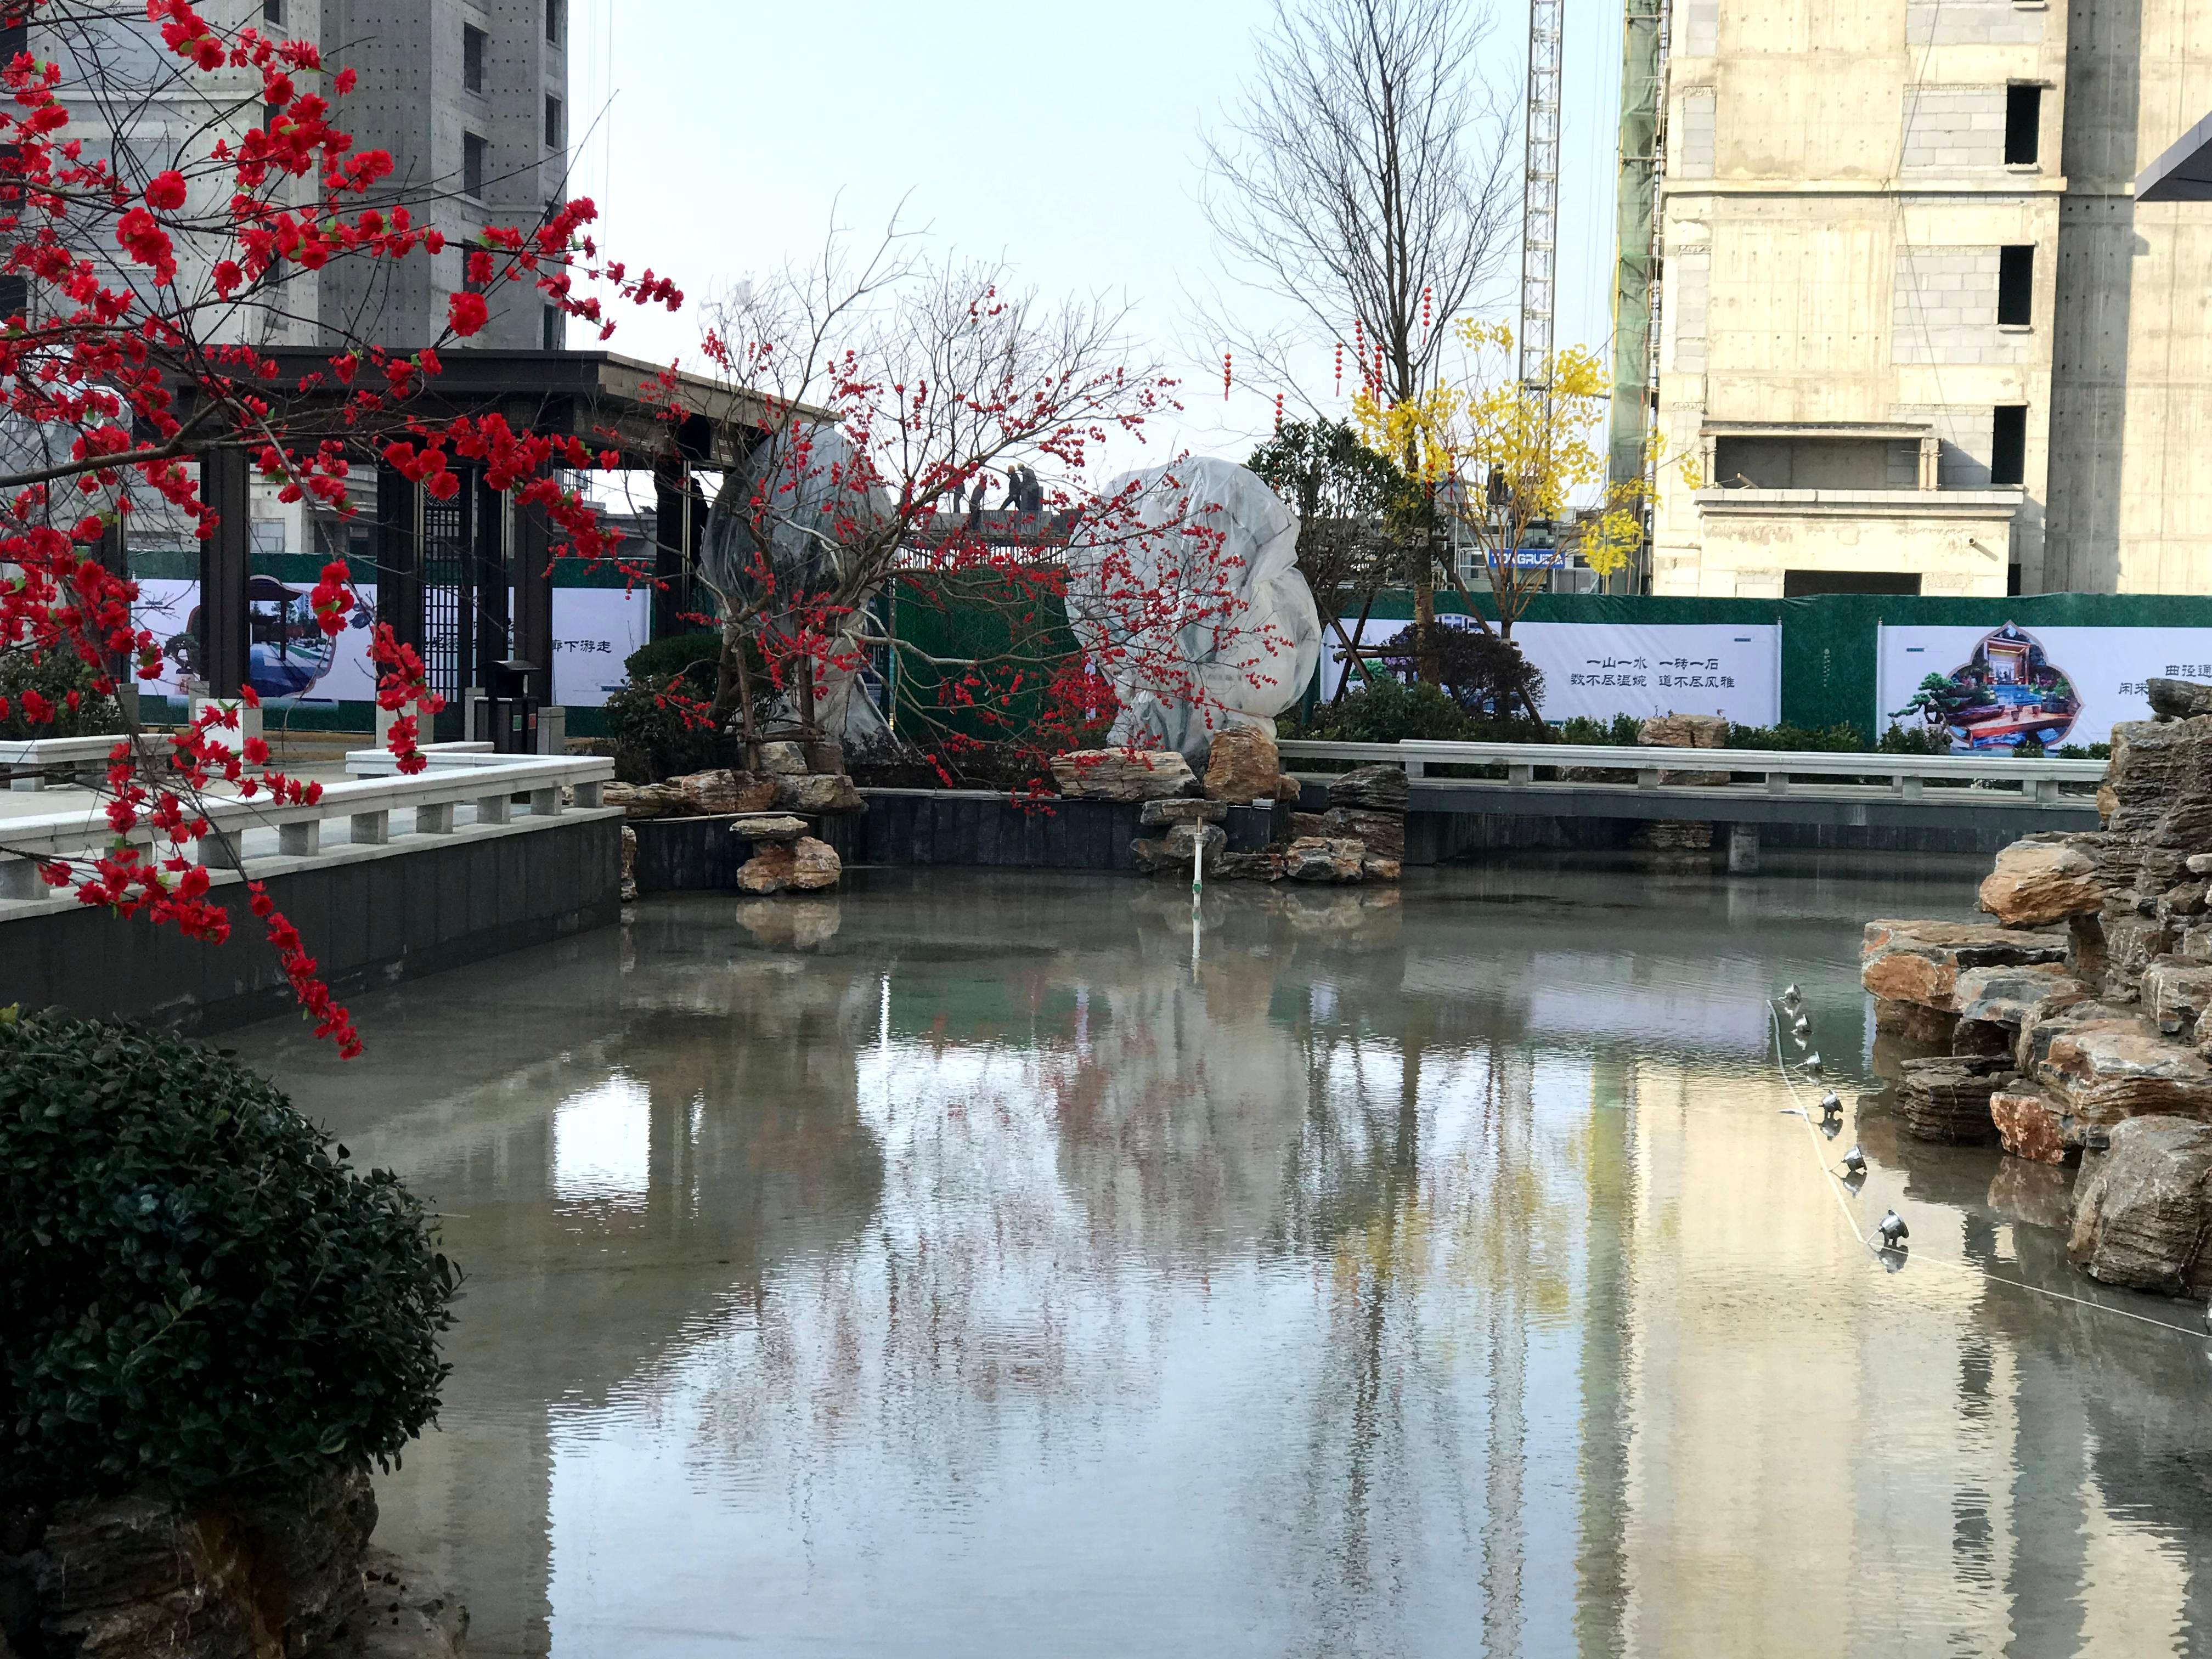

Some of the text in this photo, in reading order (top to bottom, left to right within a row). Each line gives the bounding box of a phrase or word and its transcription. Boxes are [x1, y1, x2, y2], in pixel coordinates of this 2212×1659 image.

[1587, 656, 1719, 670] 一山一水 一砖一石
[1571, 673, 1735, 688] 数不尽温婉 道不尽风雅
